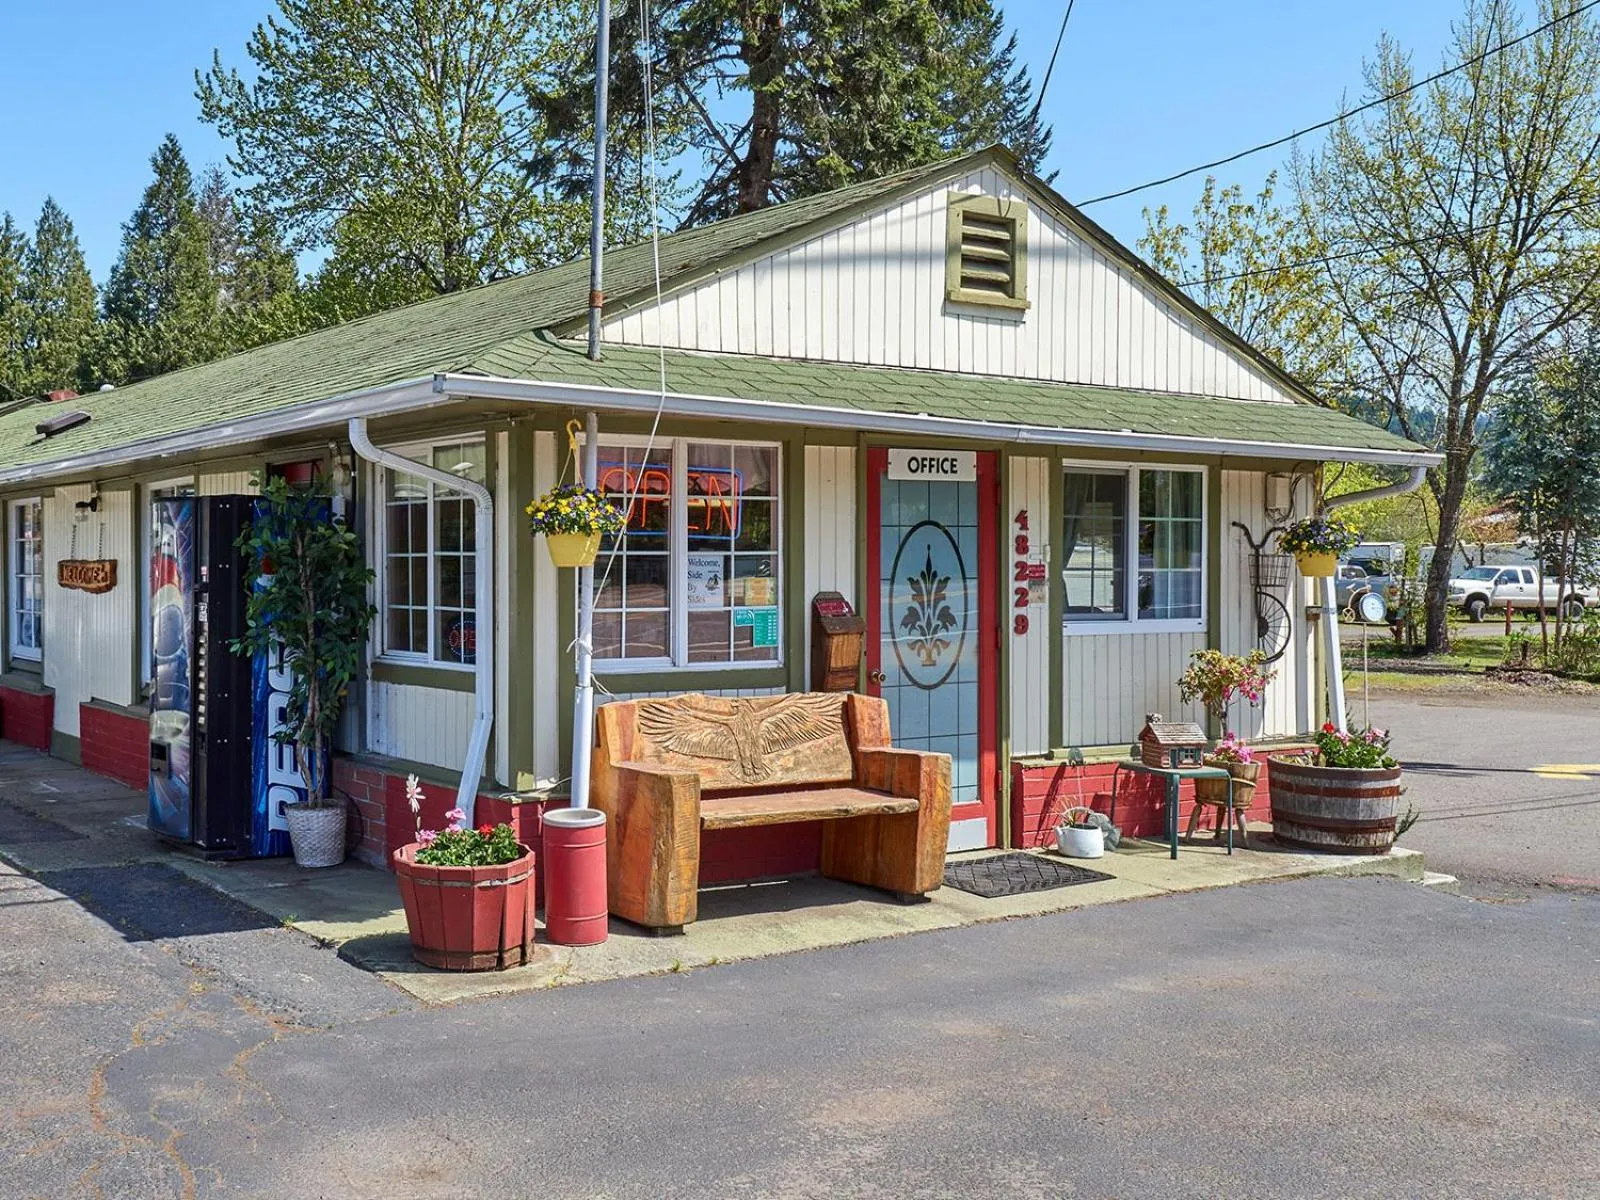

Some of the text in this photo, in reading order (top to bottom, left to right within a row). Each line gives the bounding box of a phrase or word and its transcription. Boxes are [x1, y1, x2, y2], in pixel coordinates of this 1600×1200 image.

[907, 456, 958, 475] OFFICE
[600, 468, 738, 531] OPN
[1013, 509, 1030, 636] 48229
[448, 629, 476, 650] OPE
